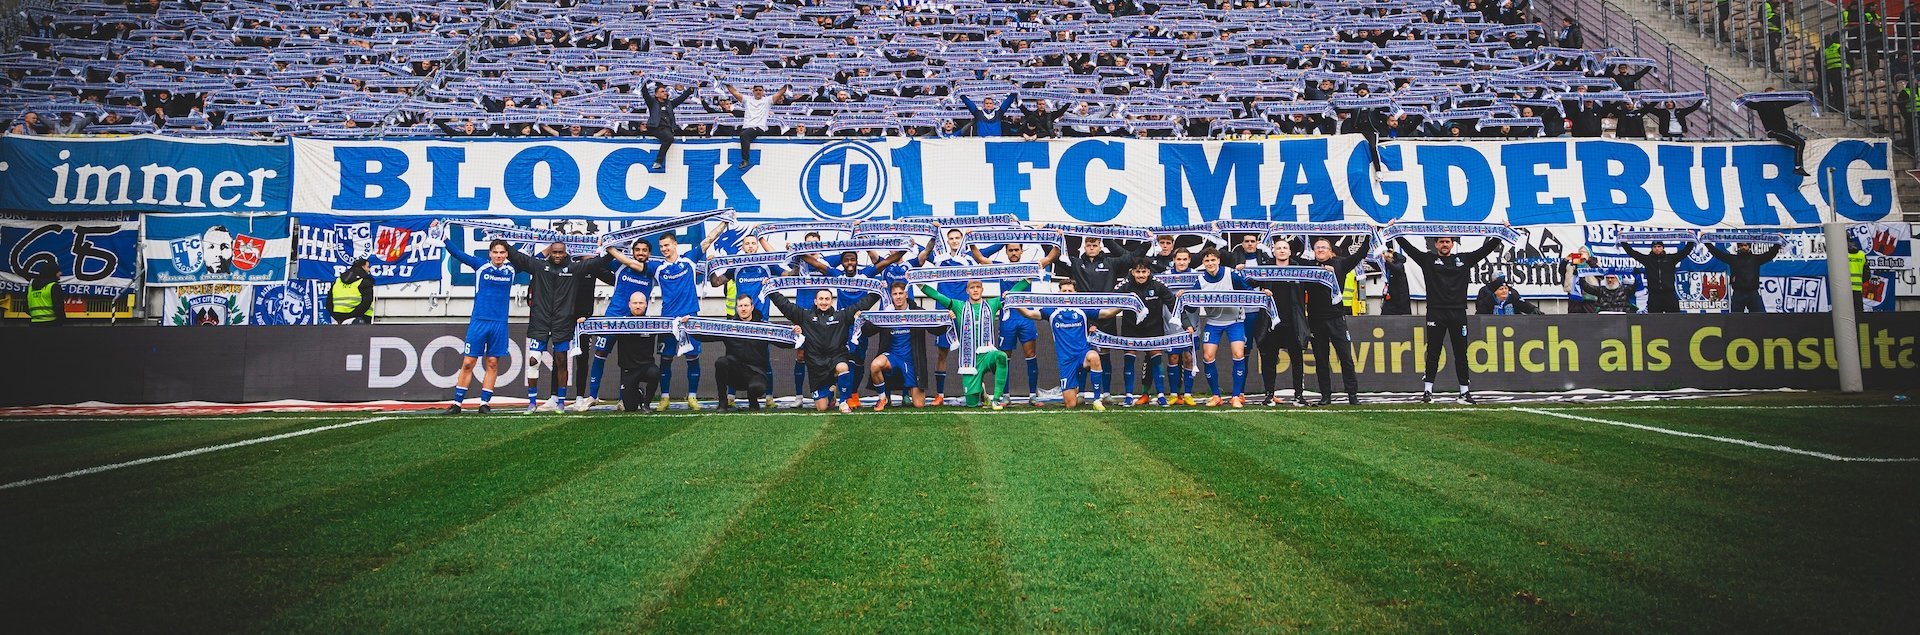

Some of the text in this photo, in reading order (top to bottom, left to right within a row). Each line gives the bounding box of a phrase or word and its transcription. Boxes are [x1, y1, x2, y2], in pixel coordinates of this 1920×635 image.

[47, 149, 277, 209] immer
[332, 145, 761, 214] BLOCK
[891, 139, 1128, 222] 1.FC
[1159, 138, 1892, 228] MAGDEBURG
[398, 265, 414, 277] U
[775, 278, 806, 288] MEIN
[69, 285, 91, 295] DER
[94, 286, 122, 297] WELT
[1679, 300, 1729, 310] BERNBURG
[594, 335, 608, 349] 29
[1467, 324, 1580, 373] dich
[1599, 324, 1672, 372] als
